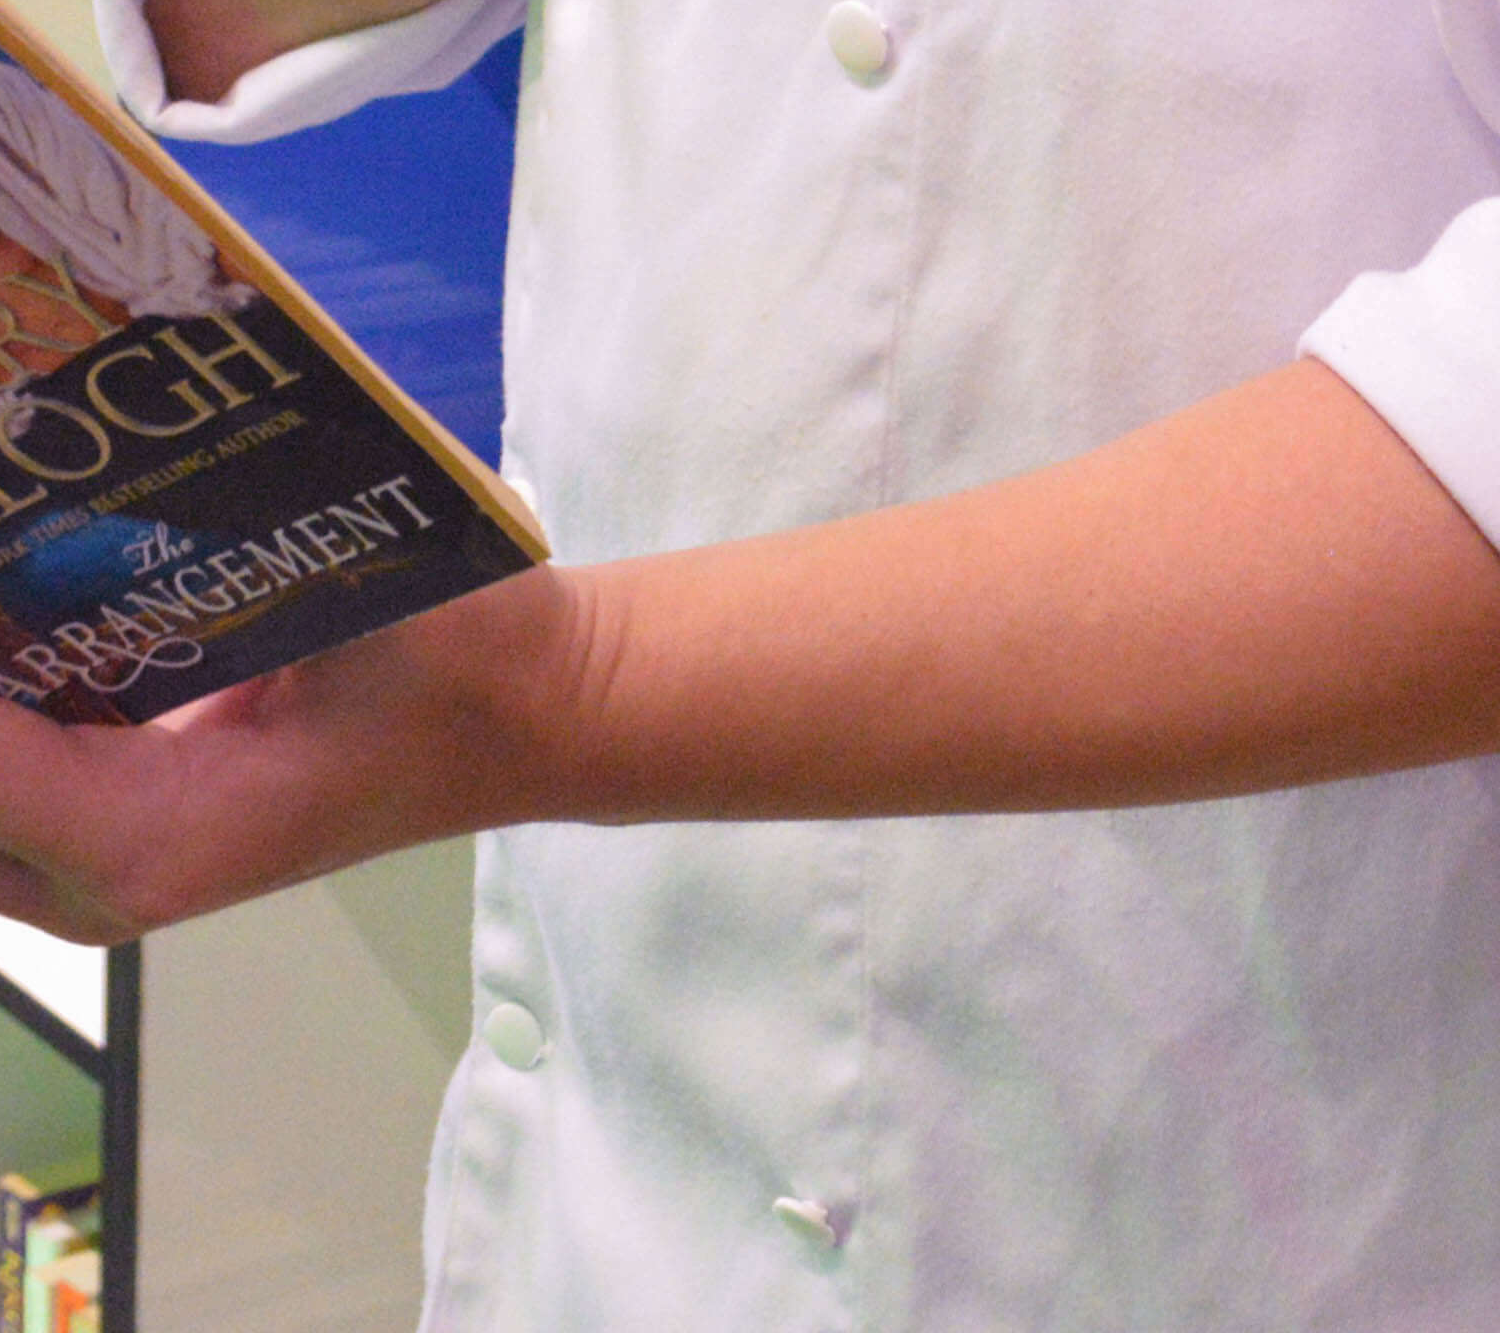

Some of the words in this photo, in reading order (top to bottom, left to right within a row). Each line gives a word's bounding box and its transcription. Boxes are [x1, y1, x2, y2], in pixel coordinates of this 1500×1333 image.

[32, 505, 91, 543] TIMES
[88, 448, 216, 515] BESTSELLING
[216, 409, 308, 458] AUTHOR
[123, 519, 195, 578] The
